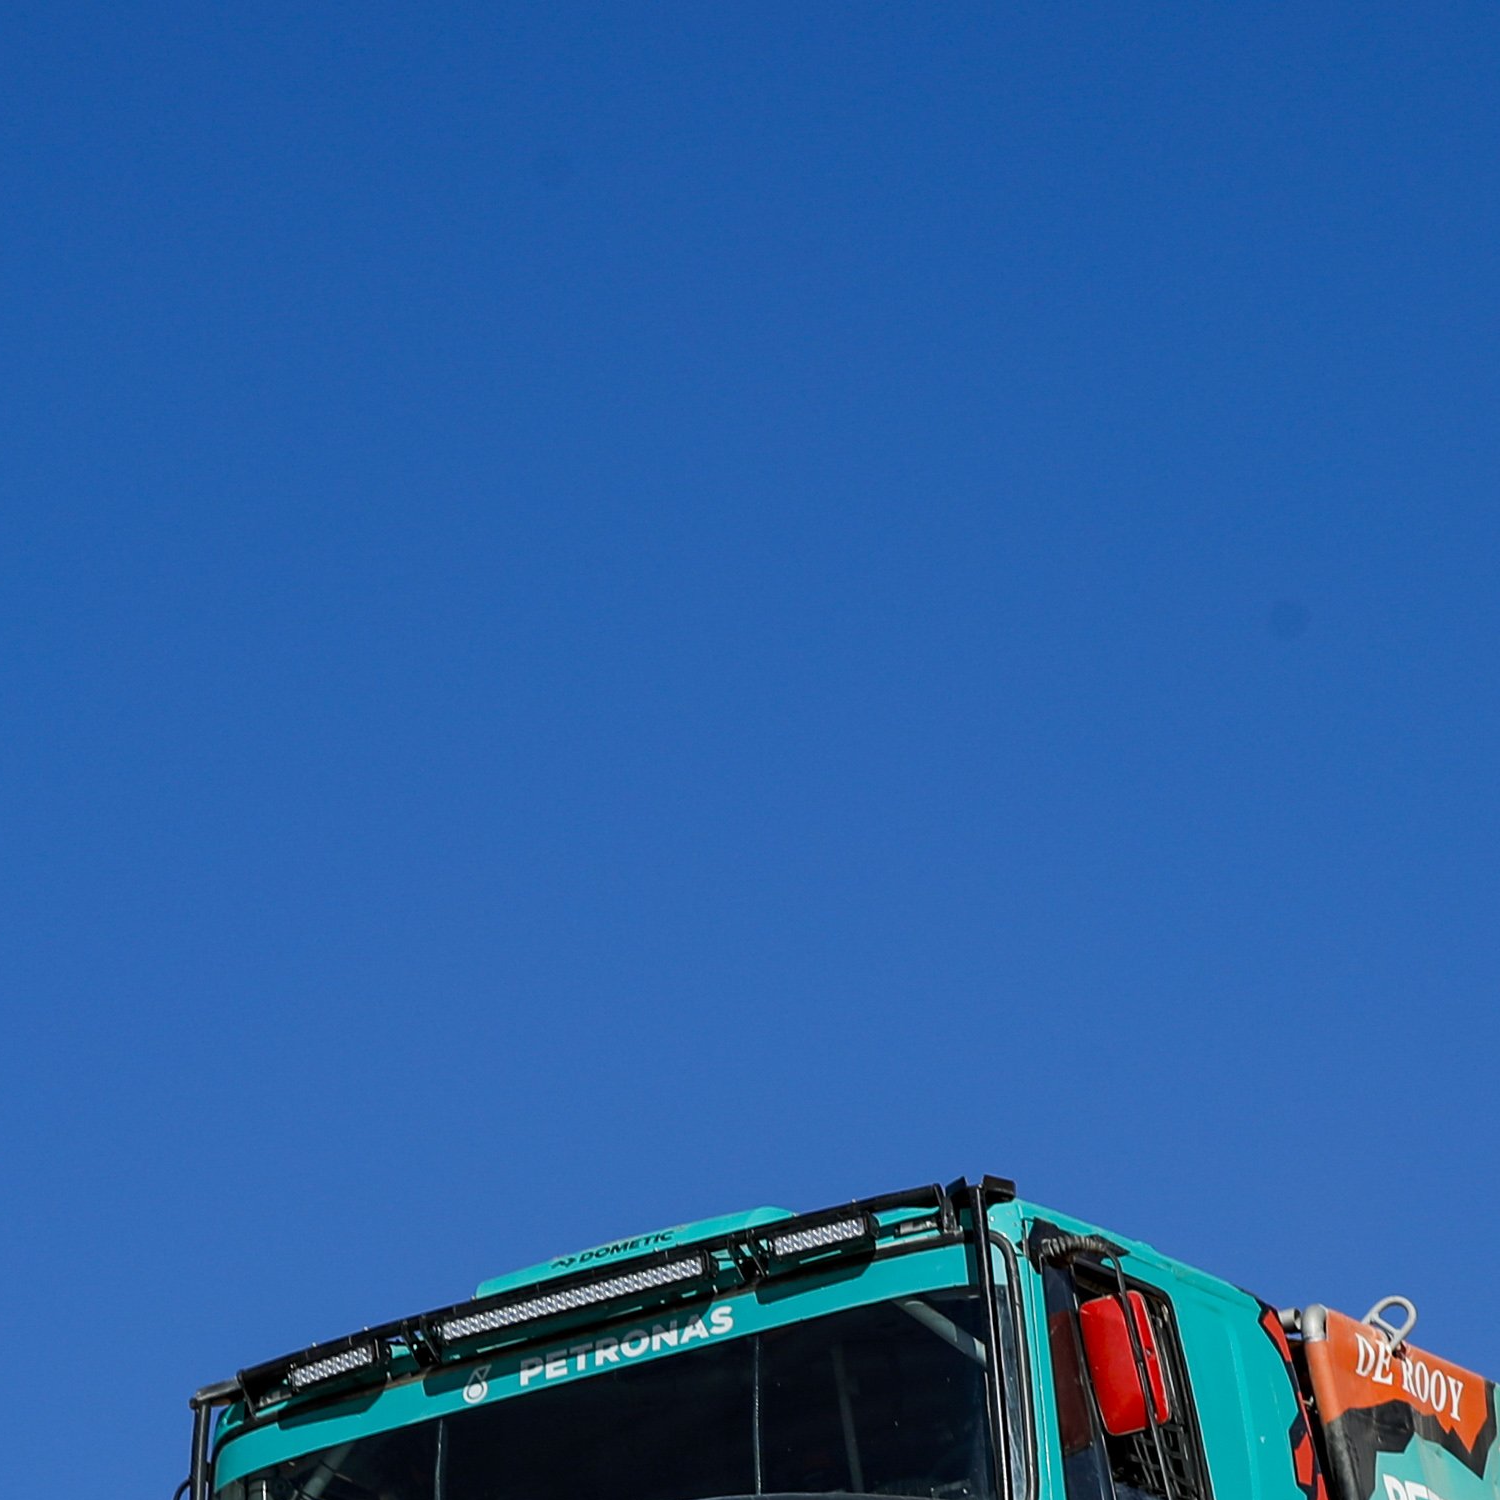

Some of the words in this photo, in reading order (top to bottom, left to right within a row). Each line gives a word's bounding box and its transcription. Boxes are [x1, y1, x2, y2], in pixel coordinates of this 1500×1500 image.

[579, 1230, 674, 1264] DOMETIC
[519, 1306, 734, 1387] PETRONAS
[1355, 1333, 1393, 1385] DE
[1402, 1356, 1464, 1421] ROOY
